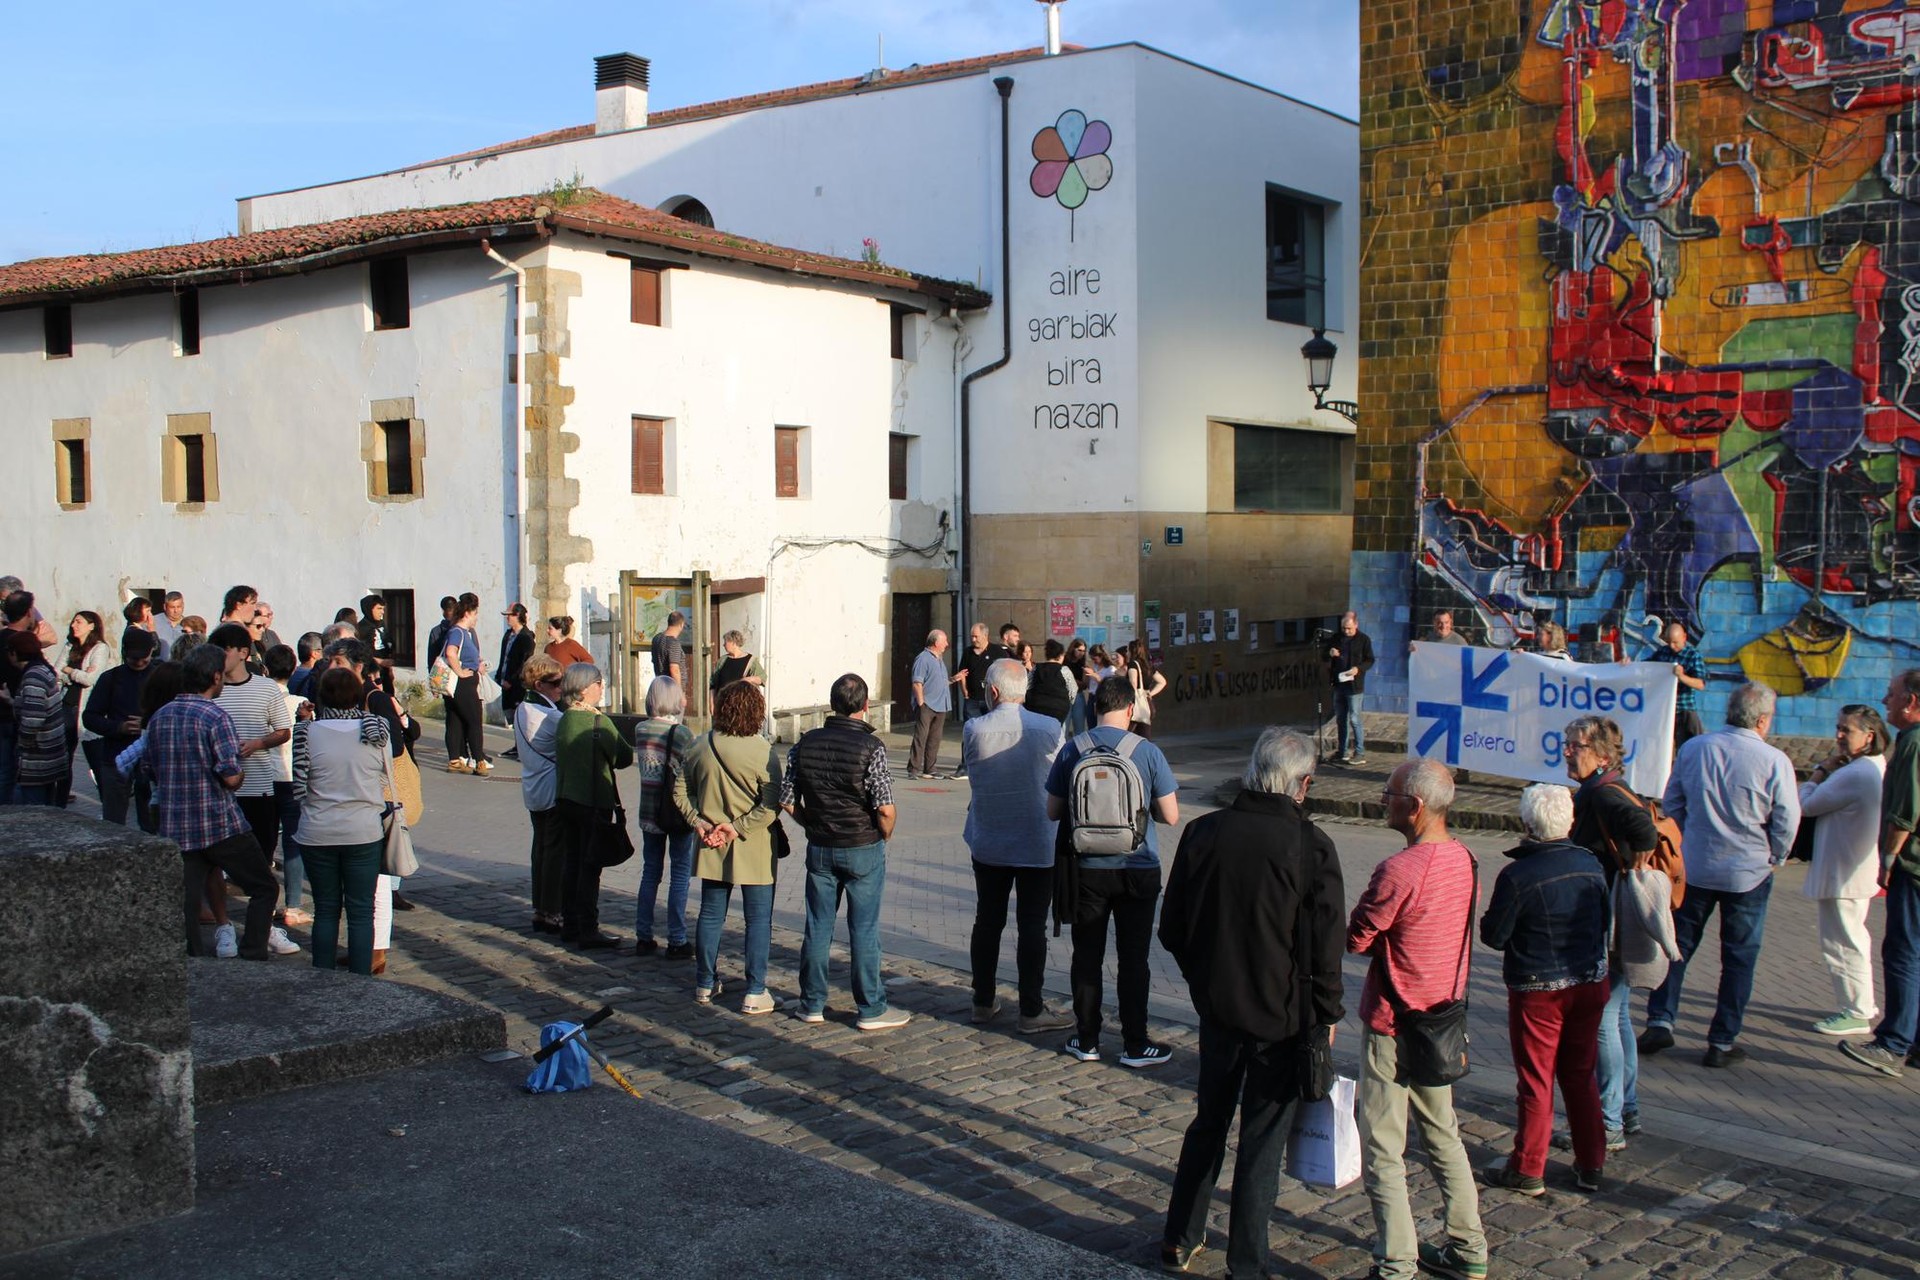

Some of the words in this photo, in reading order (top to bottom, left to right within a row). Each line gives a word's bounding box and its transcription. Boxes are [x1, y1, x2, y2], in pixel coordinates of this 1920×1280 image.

[1049, 265, 1100, 296] aire
[1028, 309, 1118, 342] garbiak
[1047, 356, 1102, 386] bira
[1034, 401, 1119, 430] nazan
[1539, 671, 1645, 713] bidea
[1463, 730, 1516, 754] eixera
